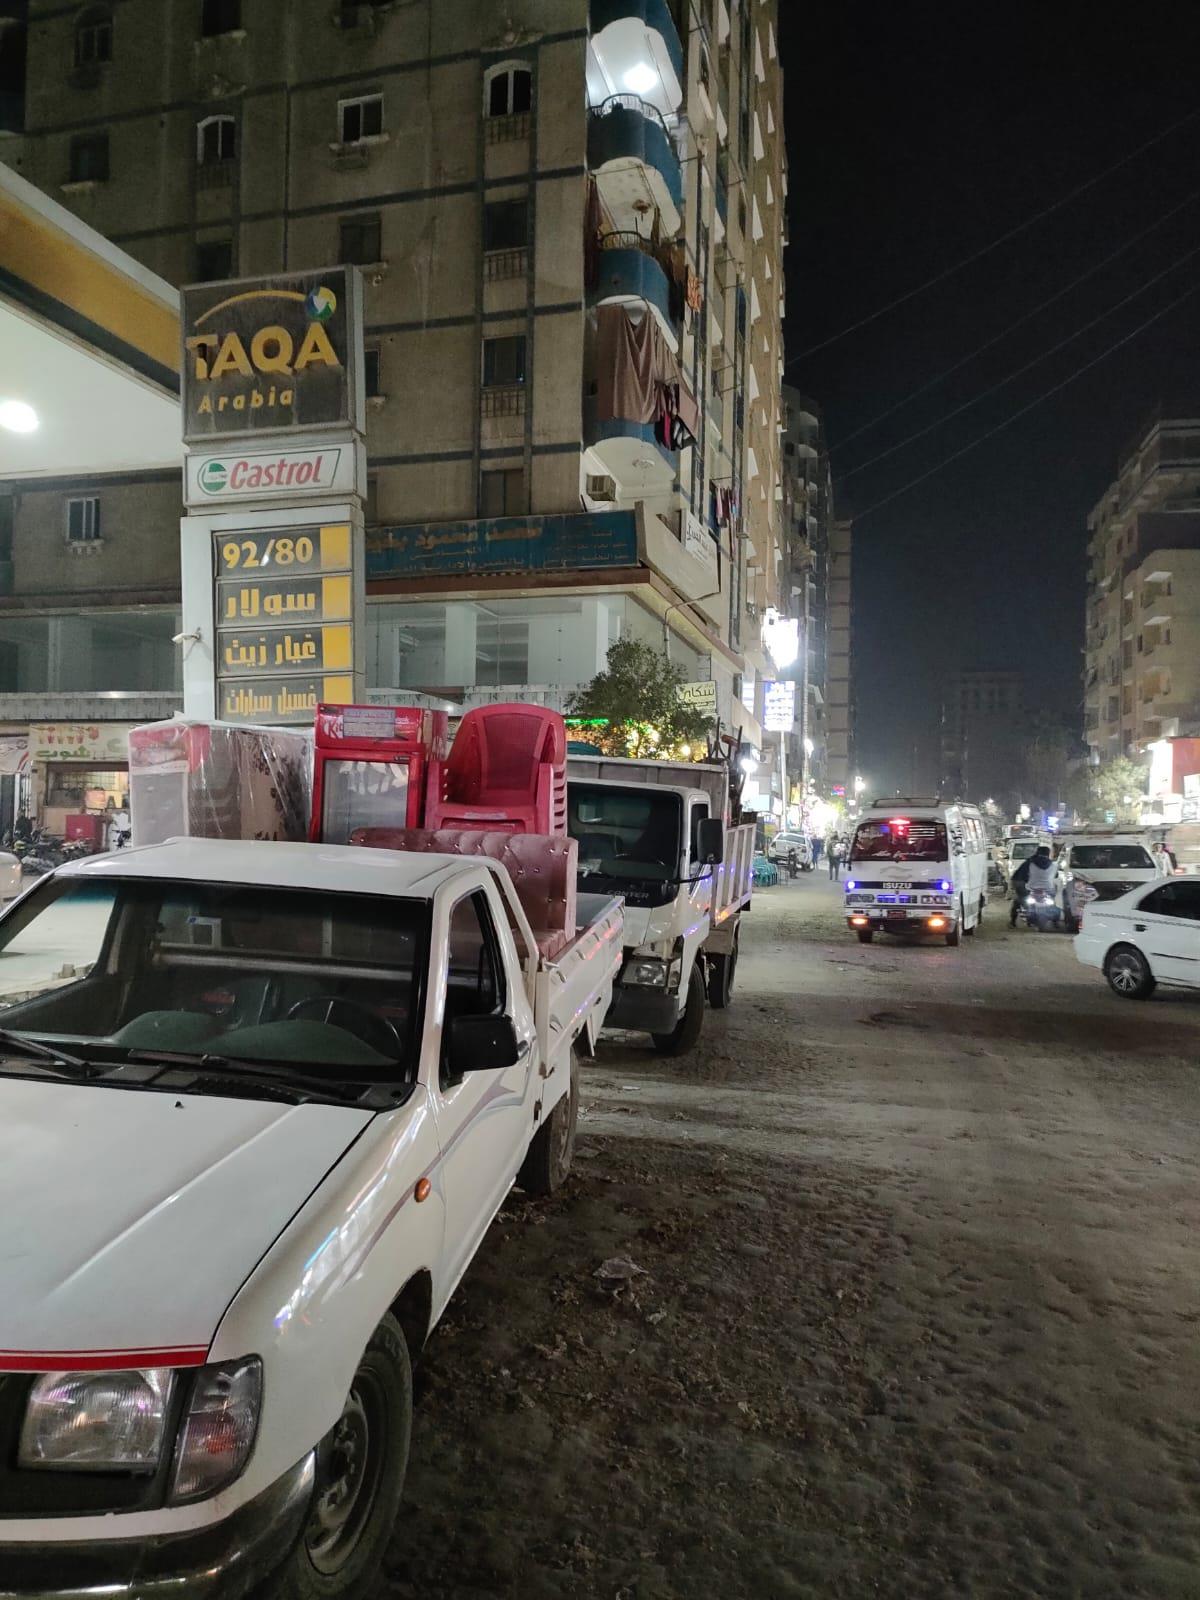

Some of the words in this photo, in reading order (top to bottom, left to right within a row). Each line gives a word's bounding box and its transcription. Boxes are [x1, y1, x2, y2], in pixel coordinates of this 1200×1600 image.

[186, 321, 344, 380] TAQA
[197, 386, 294, 414] Arabia
[230, 456, 323, 490] Castrol
[222, 536, 314, 569] 92/80
[225, 588, 316, 619] سولار
[225, 637, 267, 668] زيت
[274, 633, 316, 665] غيار
[882, 881, 912, 889] ISUZU
